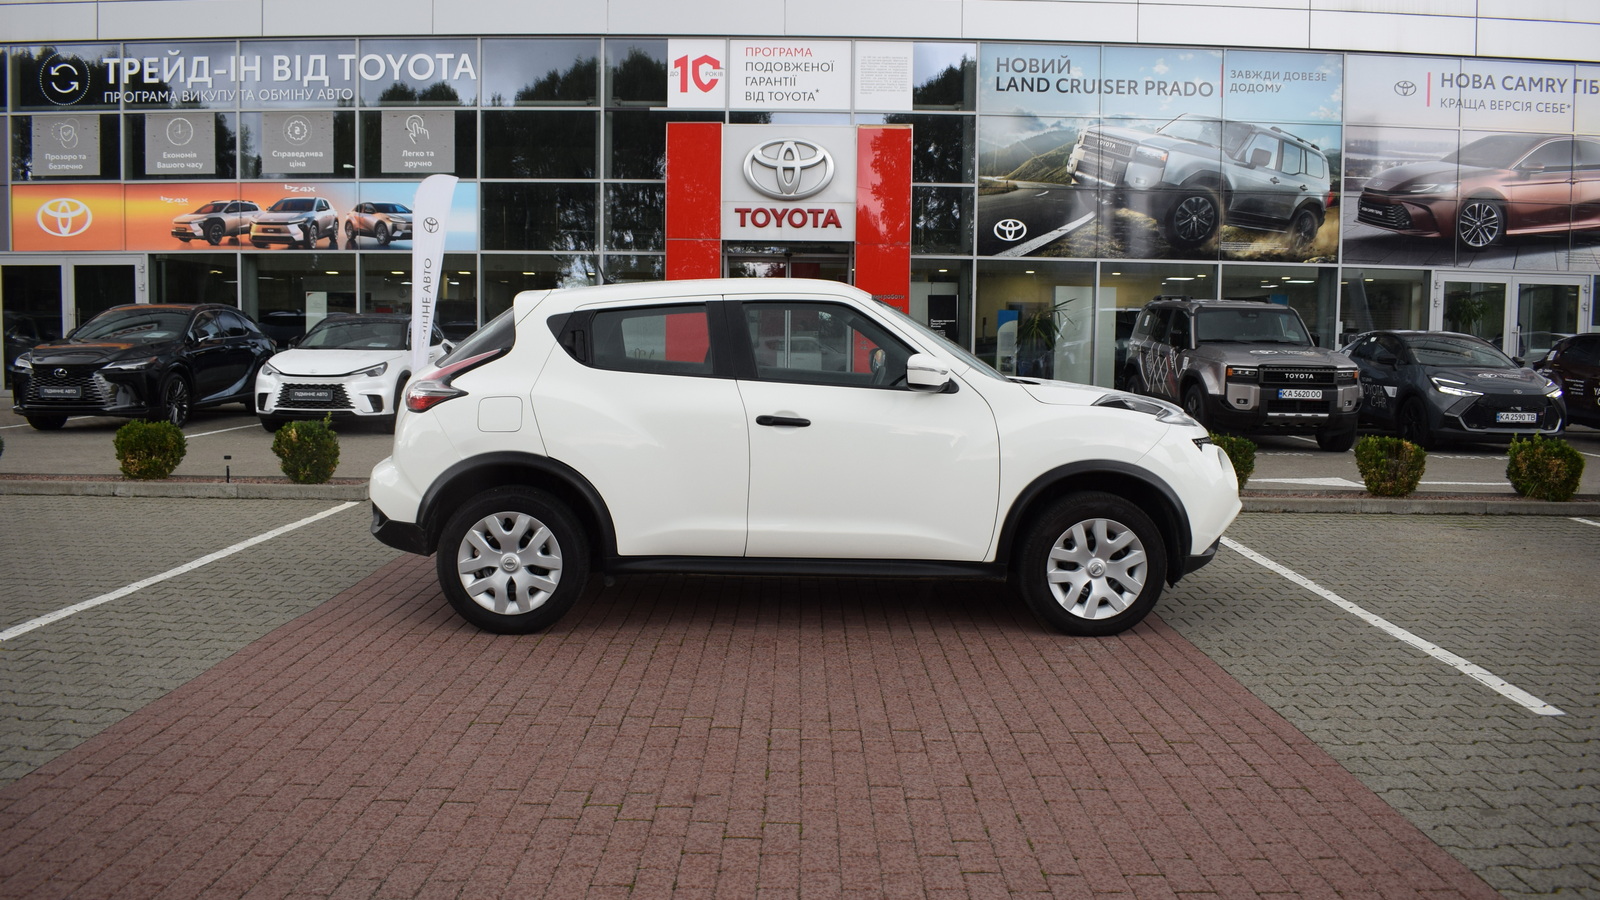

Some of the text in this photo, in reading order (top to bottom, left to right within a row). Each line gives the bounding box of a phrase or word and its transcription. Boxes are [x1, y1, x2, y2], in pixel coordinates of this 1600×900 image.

[745, 47, 813, 57] ПРОГРАМА
[102, 50, 477, 89] ТРЕЙД-ІН ВІД TOYOTA
[745, 60, 835, 73] ПОДОВЖЕНОЇ
[996, 55, 1071, 74] НОВИЙ
[745, 74, 797, 86] ГАРАНТІЇ
[1230, 70, 1327, 81] ЗАВЖДИ ДОВЕЗЕ
[996, 76, 1213, 97] LAND CRUISER PRADO
[1230, 83, 1281, 93] ДОДОМУ
[1441, 72, 1496, 90] НОВА
[1501, 75, 1568, 94] CAMRY
[104, 88, 353, 103] ПРОГРАМА ВИКУПУ ТА ОБМІНУ АВТО
[745, 91, 764, 102] ВІД
[1440, 98, 1486, 111] КРАЩА
[1490, 99, 1532, 112] ВЕРСІЯ
[1096, 140, 1116, 149] TOYOTA
[45, 153, 77, 161] Прозоро
[162, 151, 197, 159] Економія
[271, 150, 324, 159] Справедлива
[402, 150, 424, 158] Легко
[48, 162, 83, 171] безпечно
[156, 161, 203, 170] Вашого часу
[289, 160, 306, 168] ціна
[404, 161, 432, 169] зручно
[734, 208, 842, 229] TOYOTA
[423, 258, 432, 293] АВТО
[1510, 413, 1526, 421] 2590
[1527, 413, 1536, 421] TB
